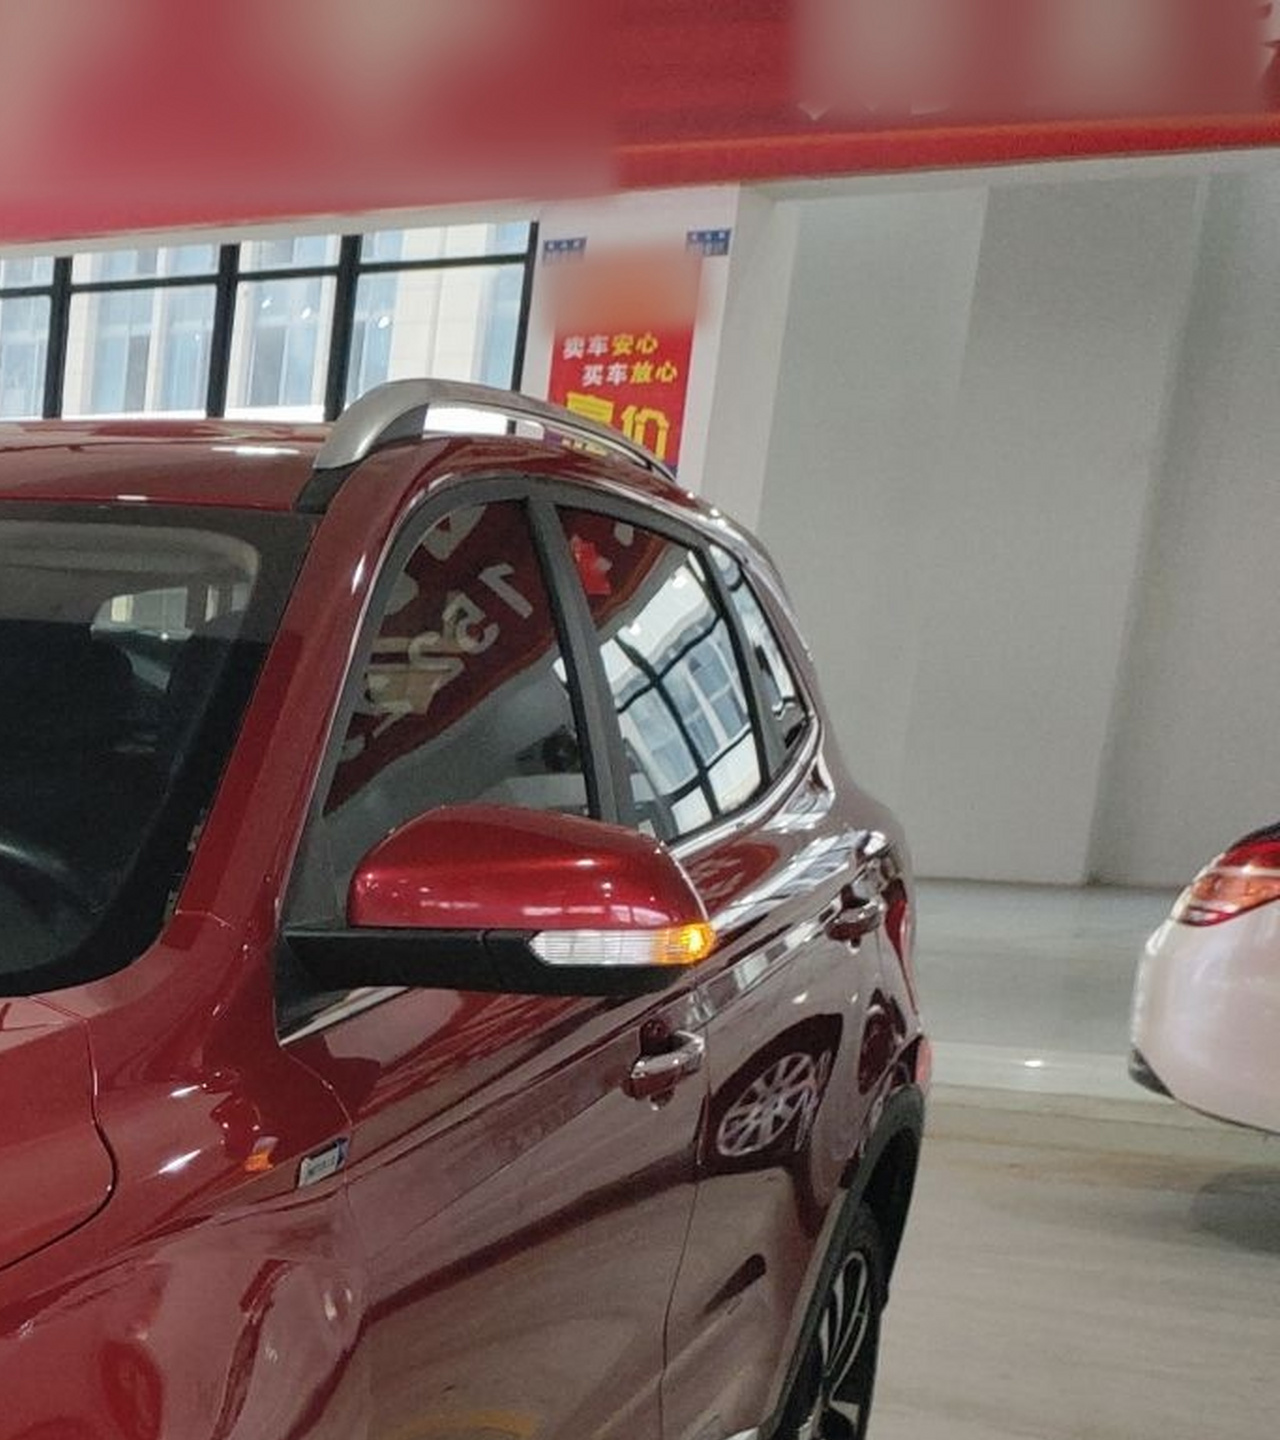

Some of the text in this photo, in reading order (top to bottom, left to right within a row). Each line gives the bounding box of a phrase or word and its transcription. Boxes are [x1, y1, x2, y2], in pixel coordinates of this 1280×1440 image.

[563, 332, 659, 360] 卖车安心
[582, 360, 678, 387] 买车放心
